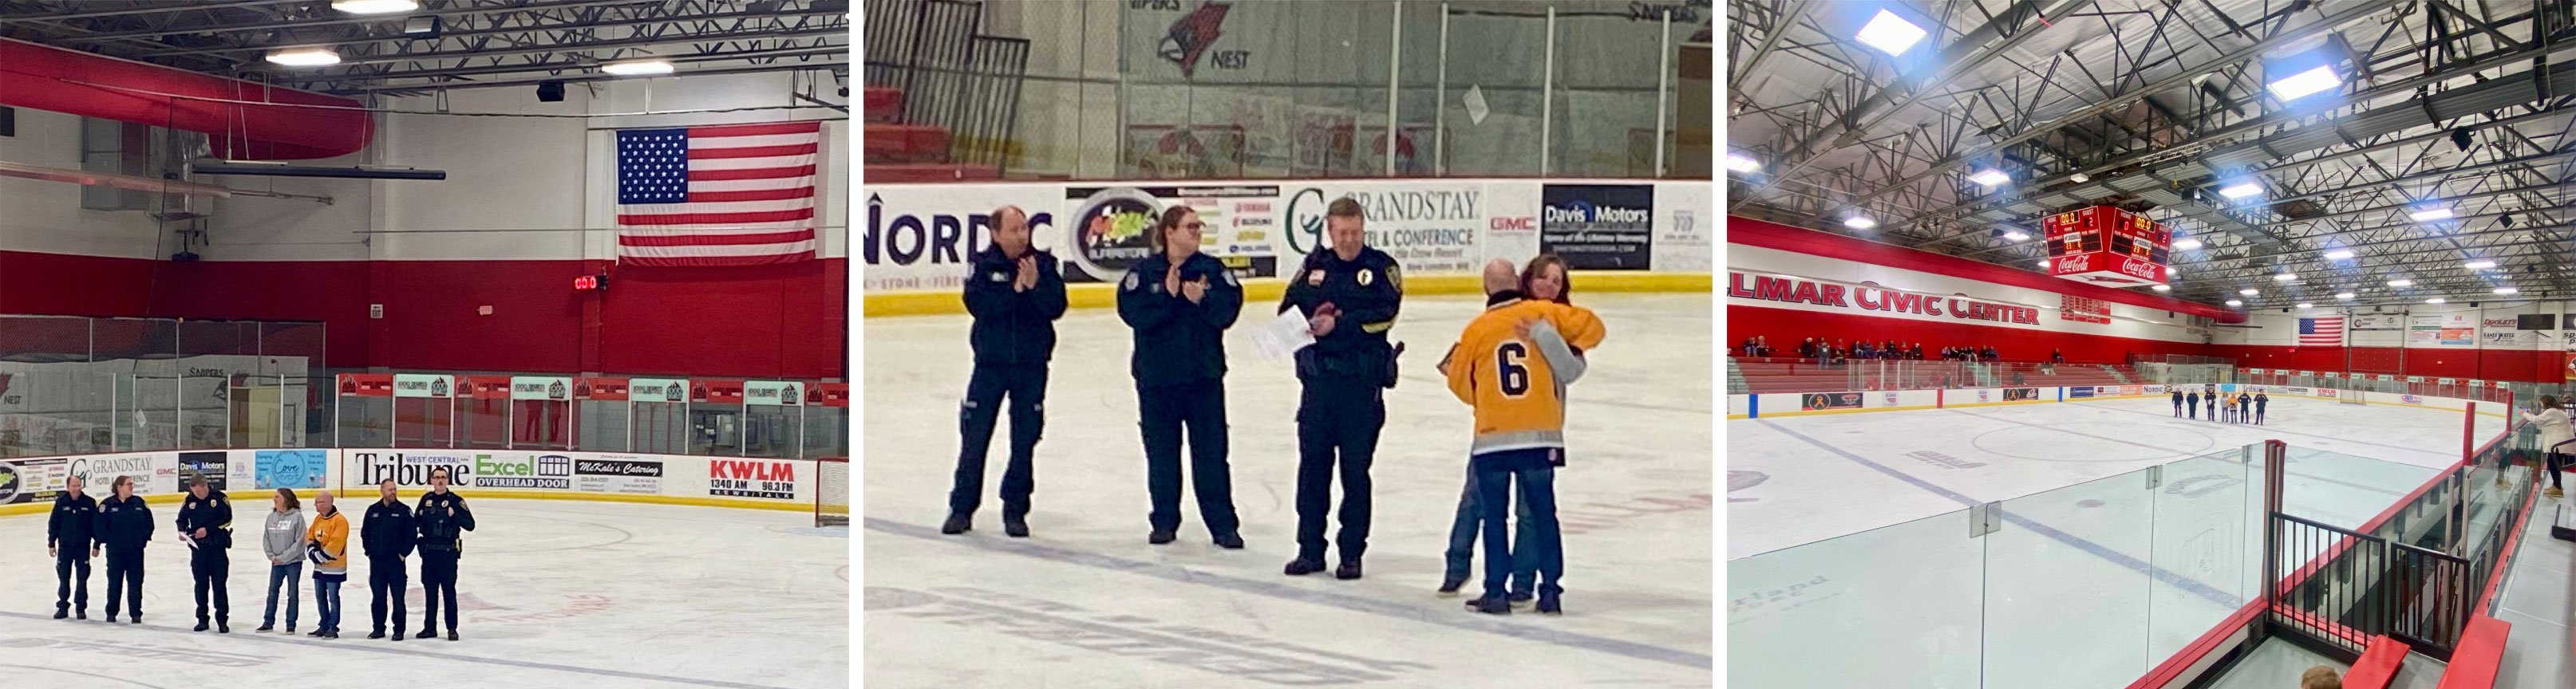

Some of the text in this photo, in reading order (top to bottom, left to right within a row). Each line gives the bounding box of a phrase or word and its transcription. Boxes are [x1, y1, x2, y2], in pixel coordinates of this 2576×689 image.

[1211, 50, 1250, 69] NEST
[1546, 204, 1648, 223] Davis Motors
[2061, 212, 2075, 224] 00.0
[863, 191, 1053, 266] ORDC
[1491, 217, 1537, 231] GMC
[2089, 217, 2093, 226] 2
[2136, 218, 2151, 230] 00.0
[1395, 228, 1473, 248] CONFERENCE
[2124, 222, 2167, 243] 0 2
[1727, 272, 1848, 308] LMAR
[1854, 281, 1942, 317] CIVIC
[1948, 293, 2041, 326] CENTER
[189, 367, 224, 377] SNIPERS
[1495, 340, 1531, 398] 6
[4, 395, 22, 405] NEST
[93, 457, 152, 474] GRANDSTAY
[156, 467, 176, 476] GMC
[180, 462, 199, 470] Davis
[275, 459, 299, 474] Cove
[476, 454, 535, 477] Excel
[579, 462, 659, 476] McKale's Catering
[710, 460, 795, 482] KWLM
[477, 478, 568, 488] OVERHEAD DOOR
[711, 479, 732, 489] 1340
[734, 481, 748, 490] AM
